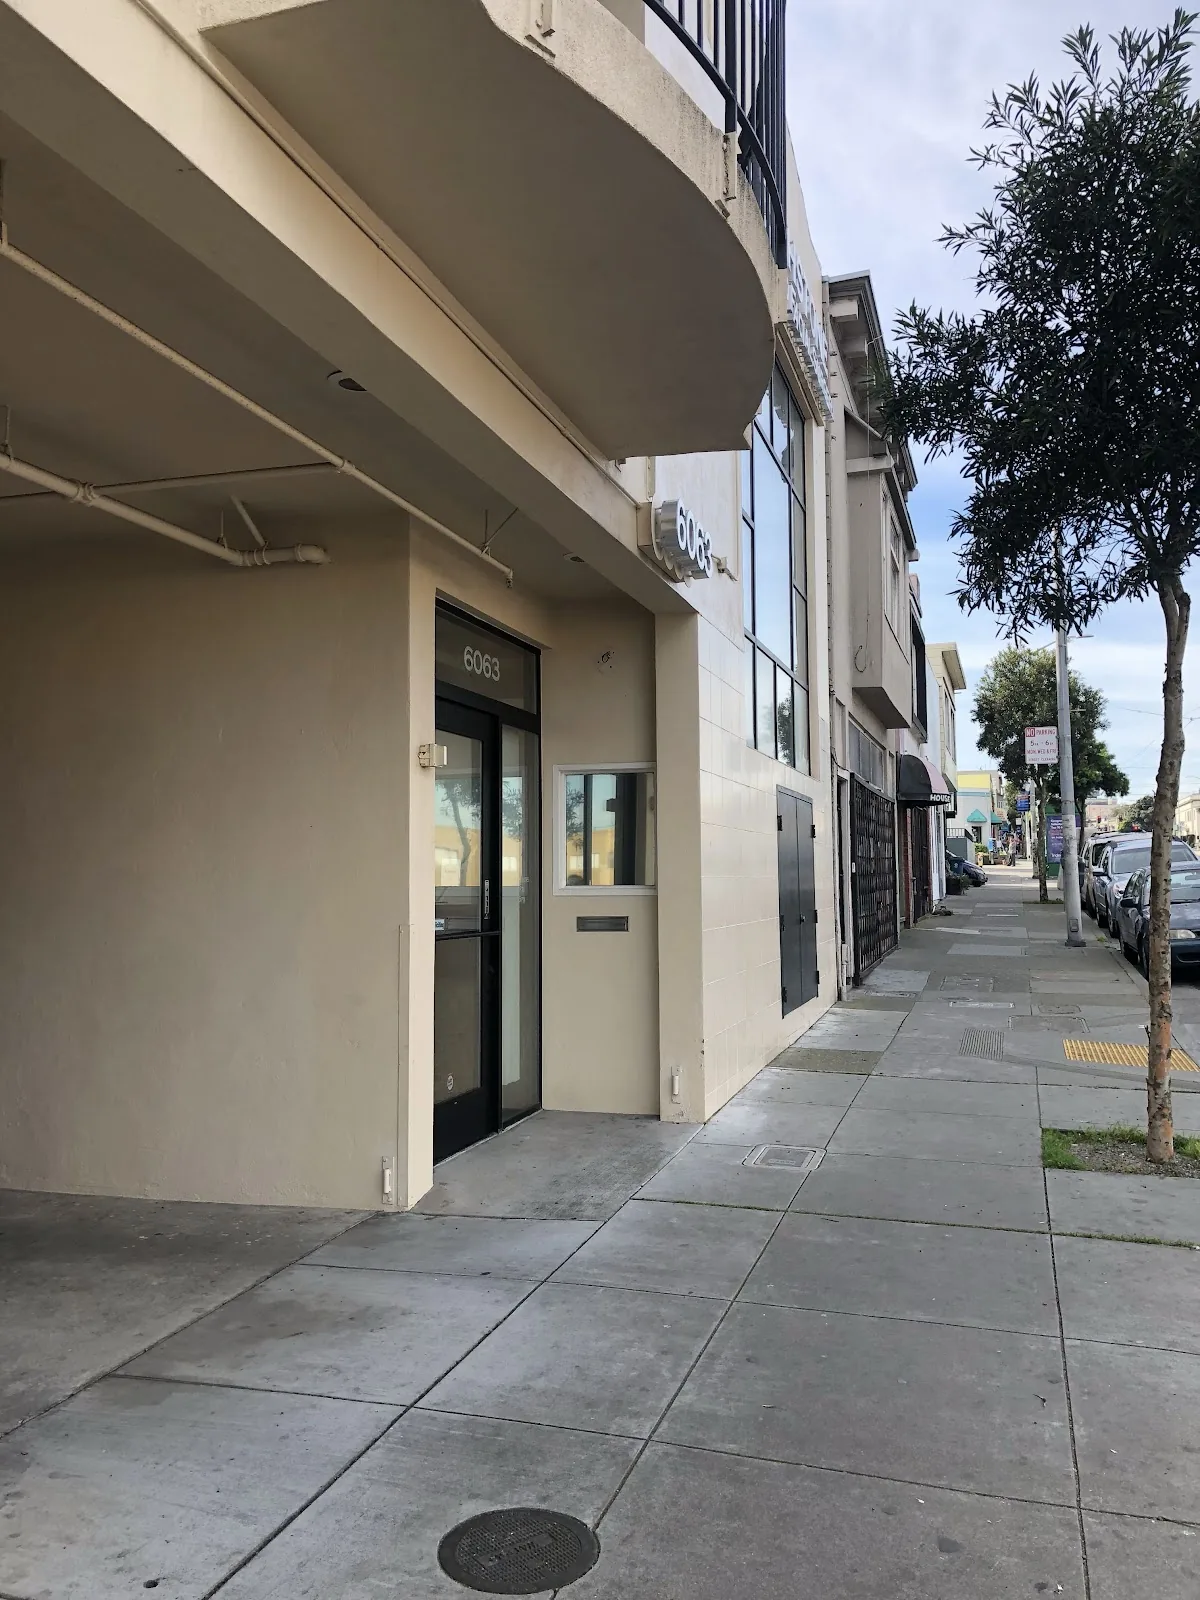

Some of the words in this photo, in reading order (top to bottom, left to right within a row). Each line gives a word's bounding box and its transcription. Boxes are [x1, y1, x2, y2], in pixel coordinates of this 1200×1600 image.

[677, 498, 713, 579] 6063
[464, 645, 500, 681] 6063
[1026, 728, 1035, 737] NO
[930, 794, 951, 803] HOUSE
